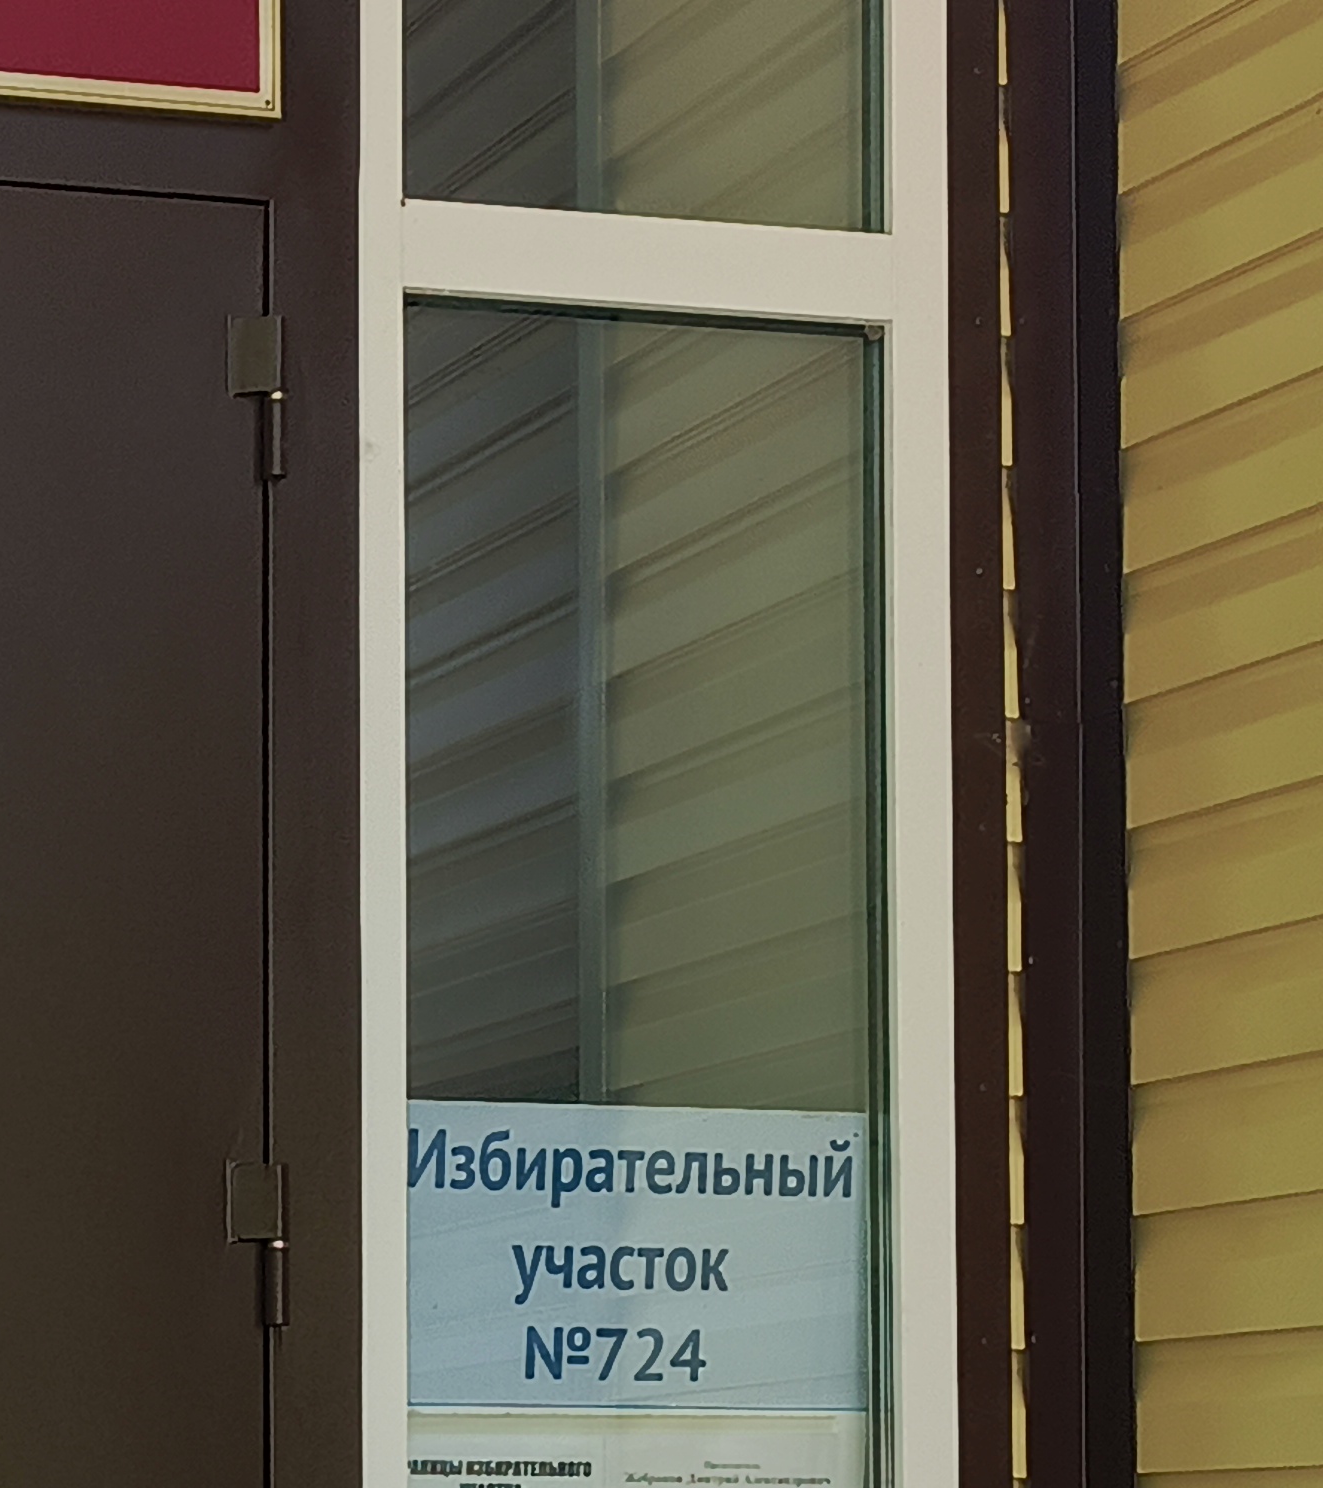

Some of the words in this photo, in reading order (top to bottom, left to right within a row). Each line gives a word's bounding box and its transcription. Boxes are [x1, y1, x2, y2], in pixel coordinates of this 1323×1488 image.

[407, 1127, 853, 1208] Избирательный
[512, 1244, 729, 1305] участок
[524, 1325, 707, 1383] №724
